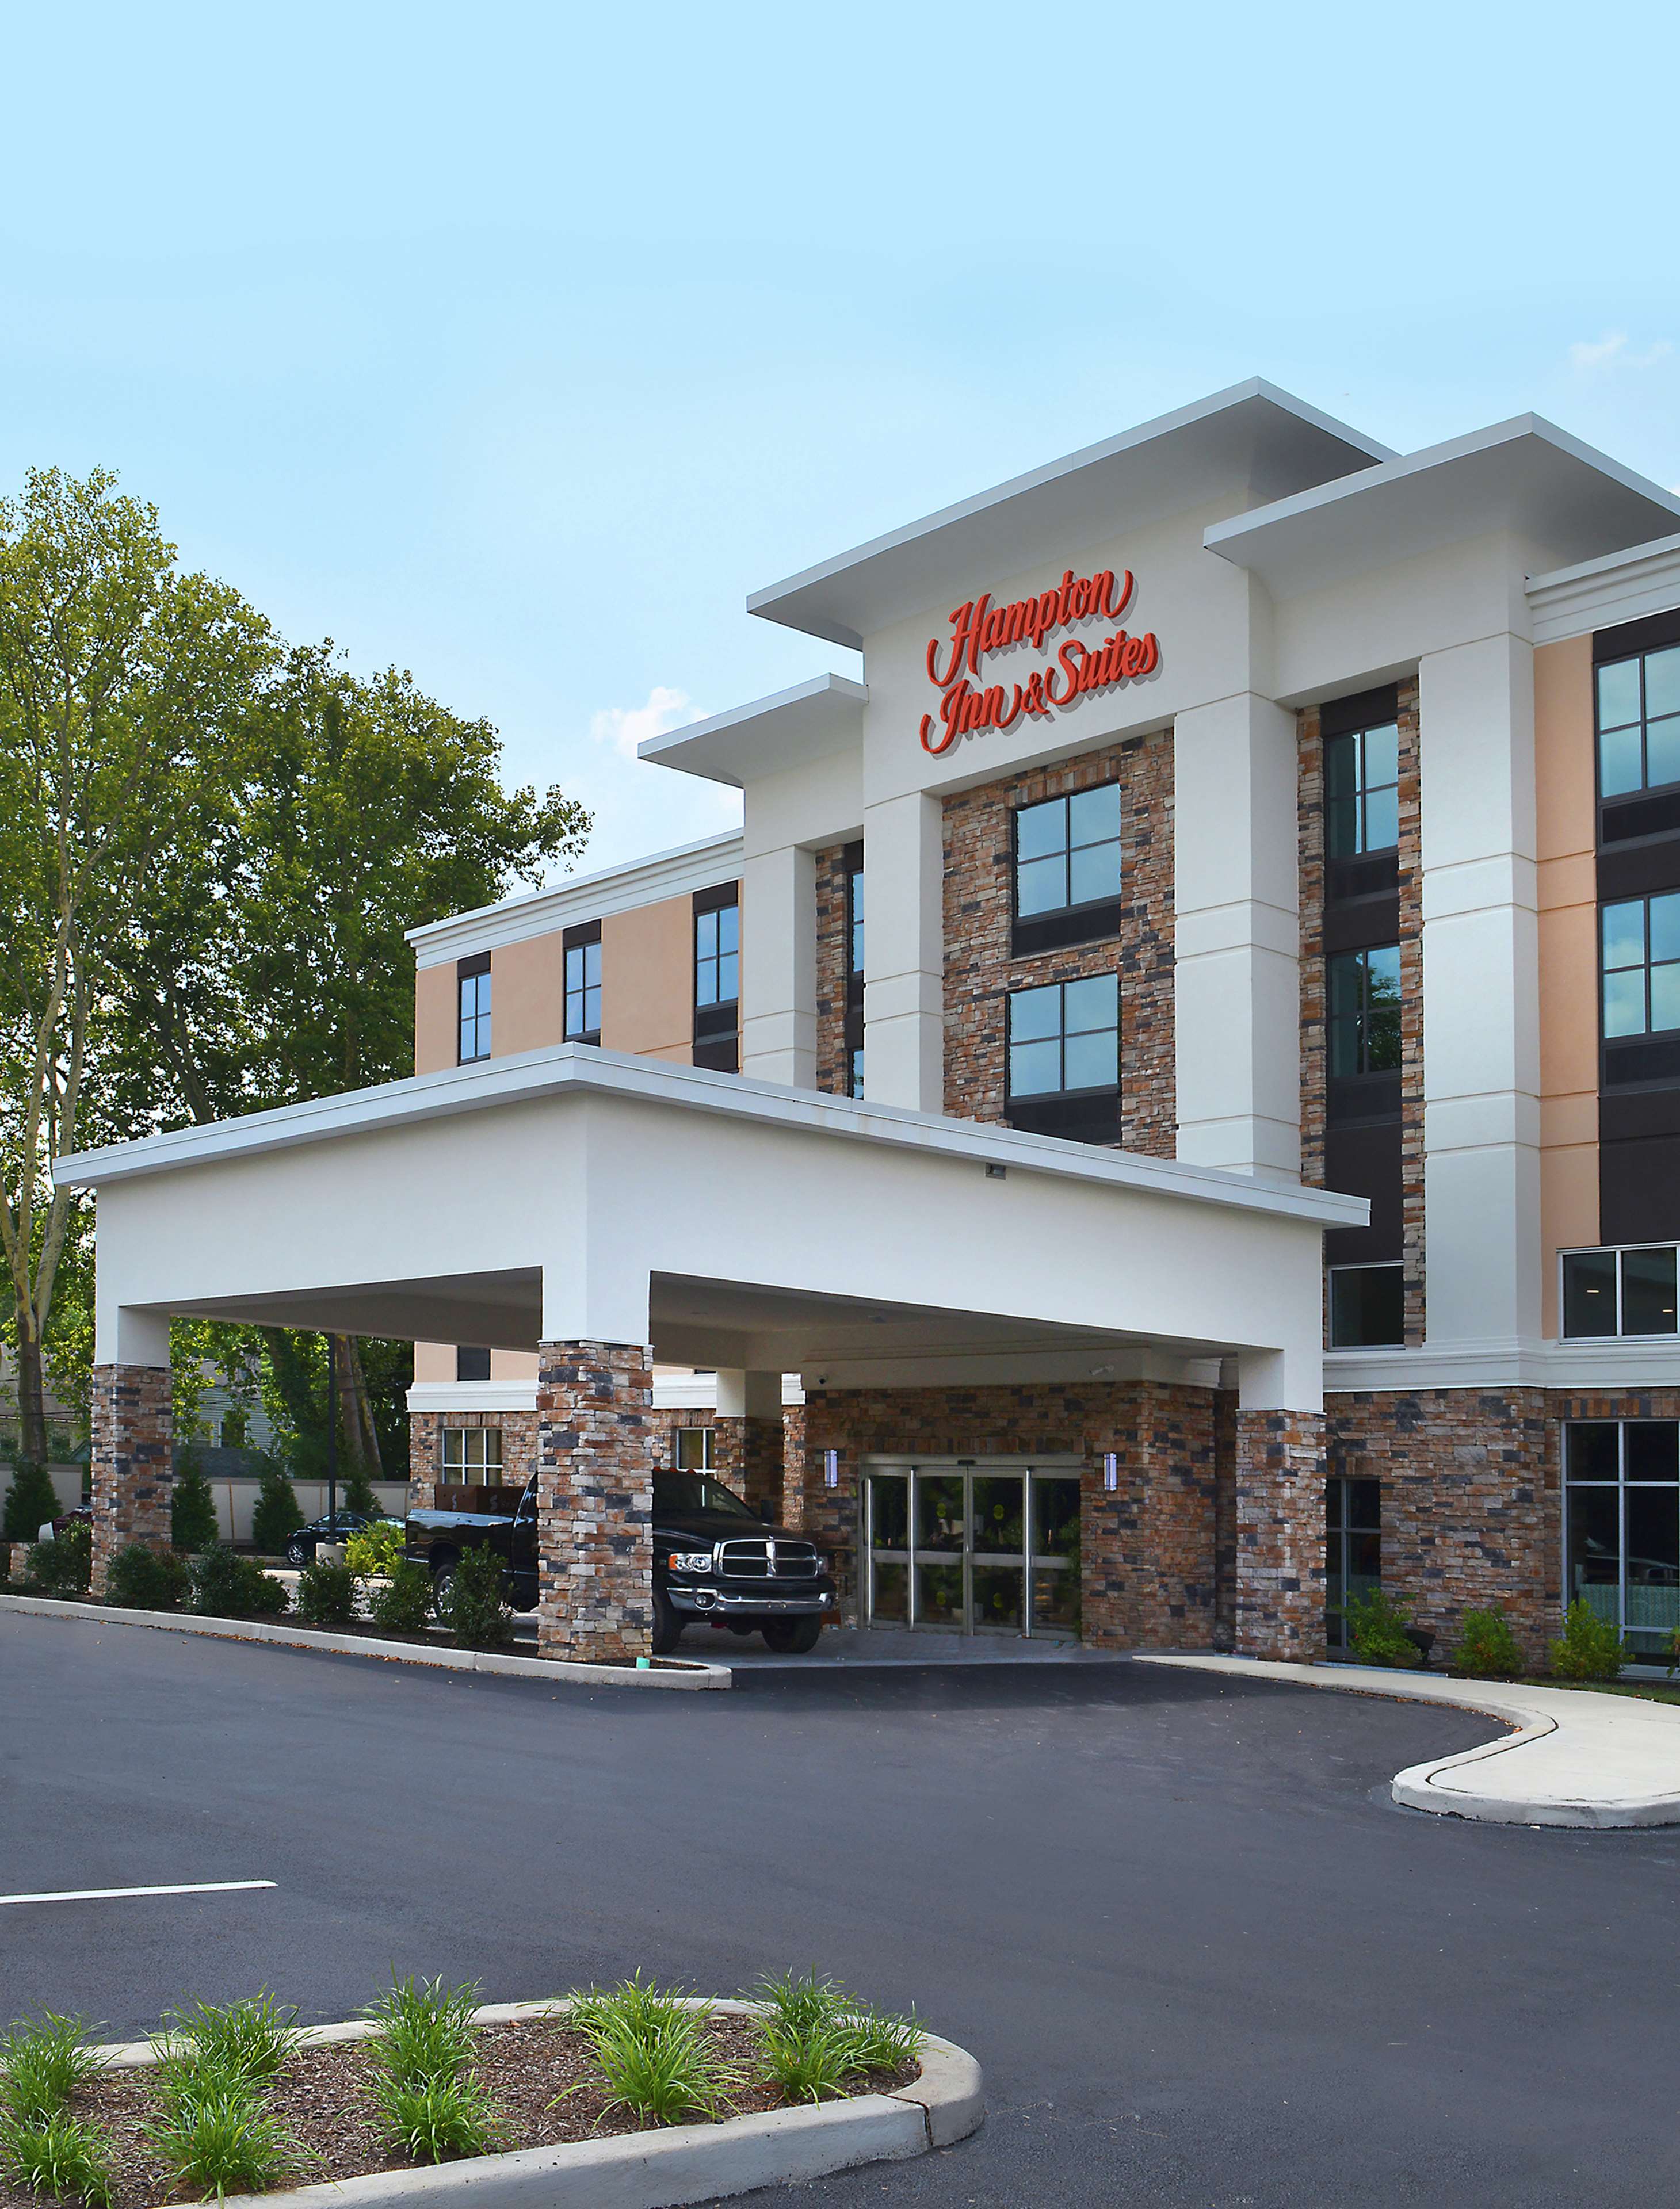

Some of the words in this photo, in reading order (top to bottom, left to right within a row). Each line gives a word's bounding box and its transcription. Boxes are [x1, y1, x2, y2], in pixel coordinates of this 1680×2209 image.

[926, 570, 1133, 687] Hampton
[919, 679, 1022, 754] Inn
[1020, 672, 1051, 714] &
[1044, 630, 1159, 706] Suites
